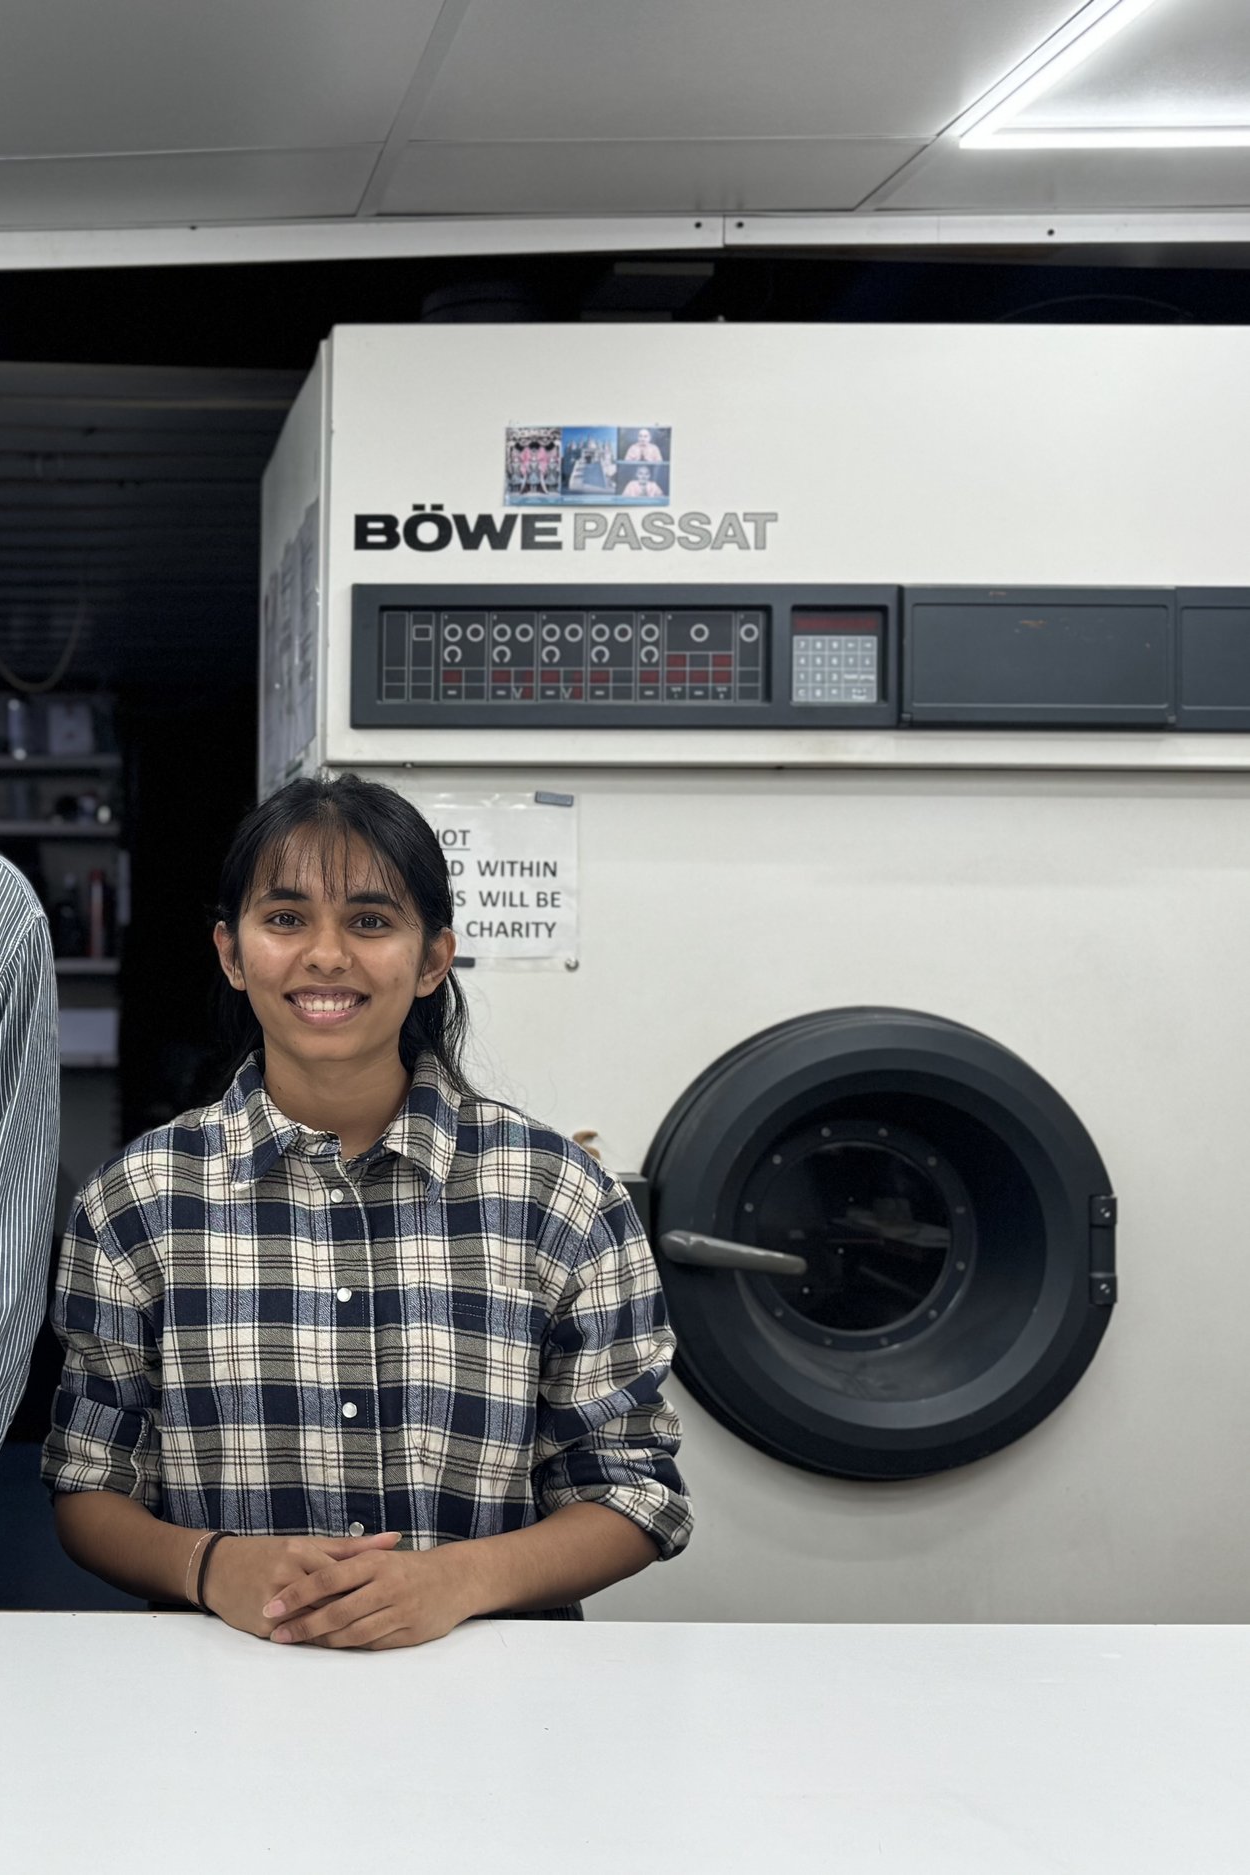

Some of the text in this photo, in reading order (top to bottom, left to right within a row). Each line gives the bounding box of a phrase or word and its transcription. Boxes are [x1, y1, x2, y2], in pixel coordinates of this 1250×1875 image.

[354, 504, 778, 552] BÖWE PASSAT
[477, 860, 557, 877] WITHIN
[479, 891, 530, 908] WILL
[536, 891, 562, 908] BE
[466, 920, 557, 938] CHARITY
